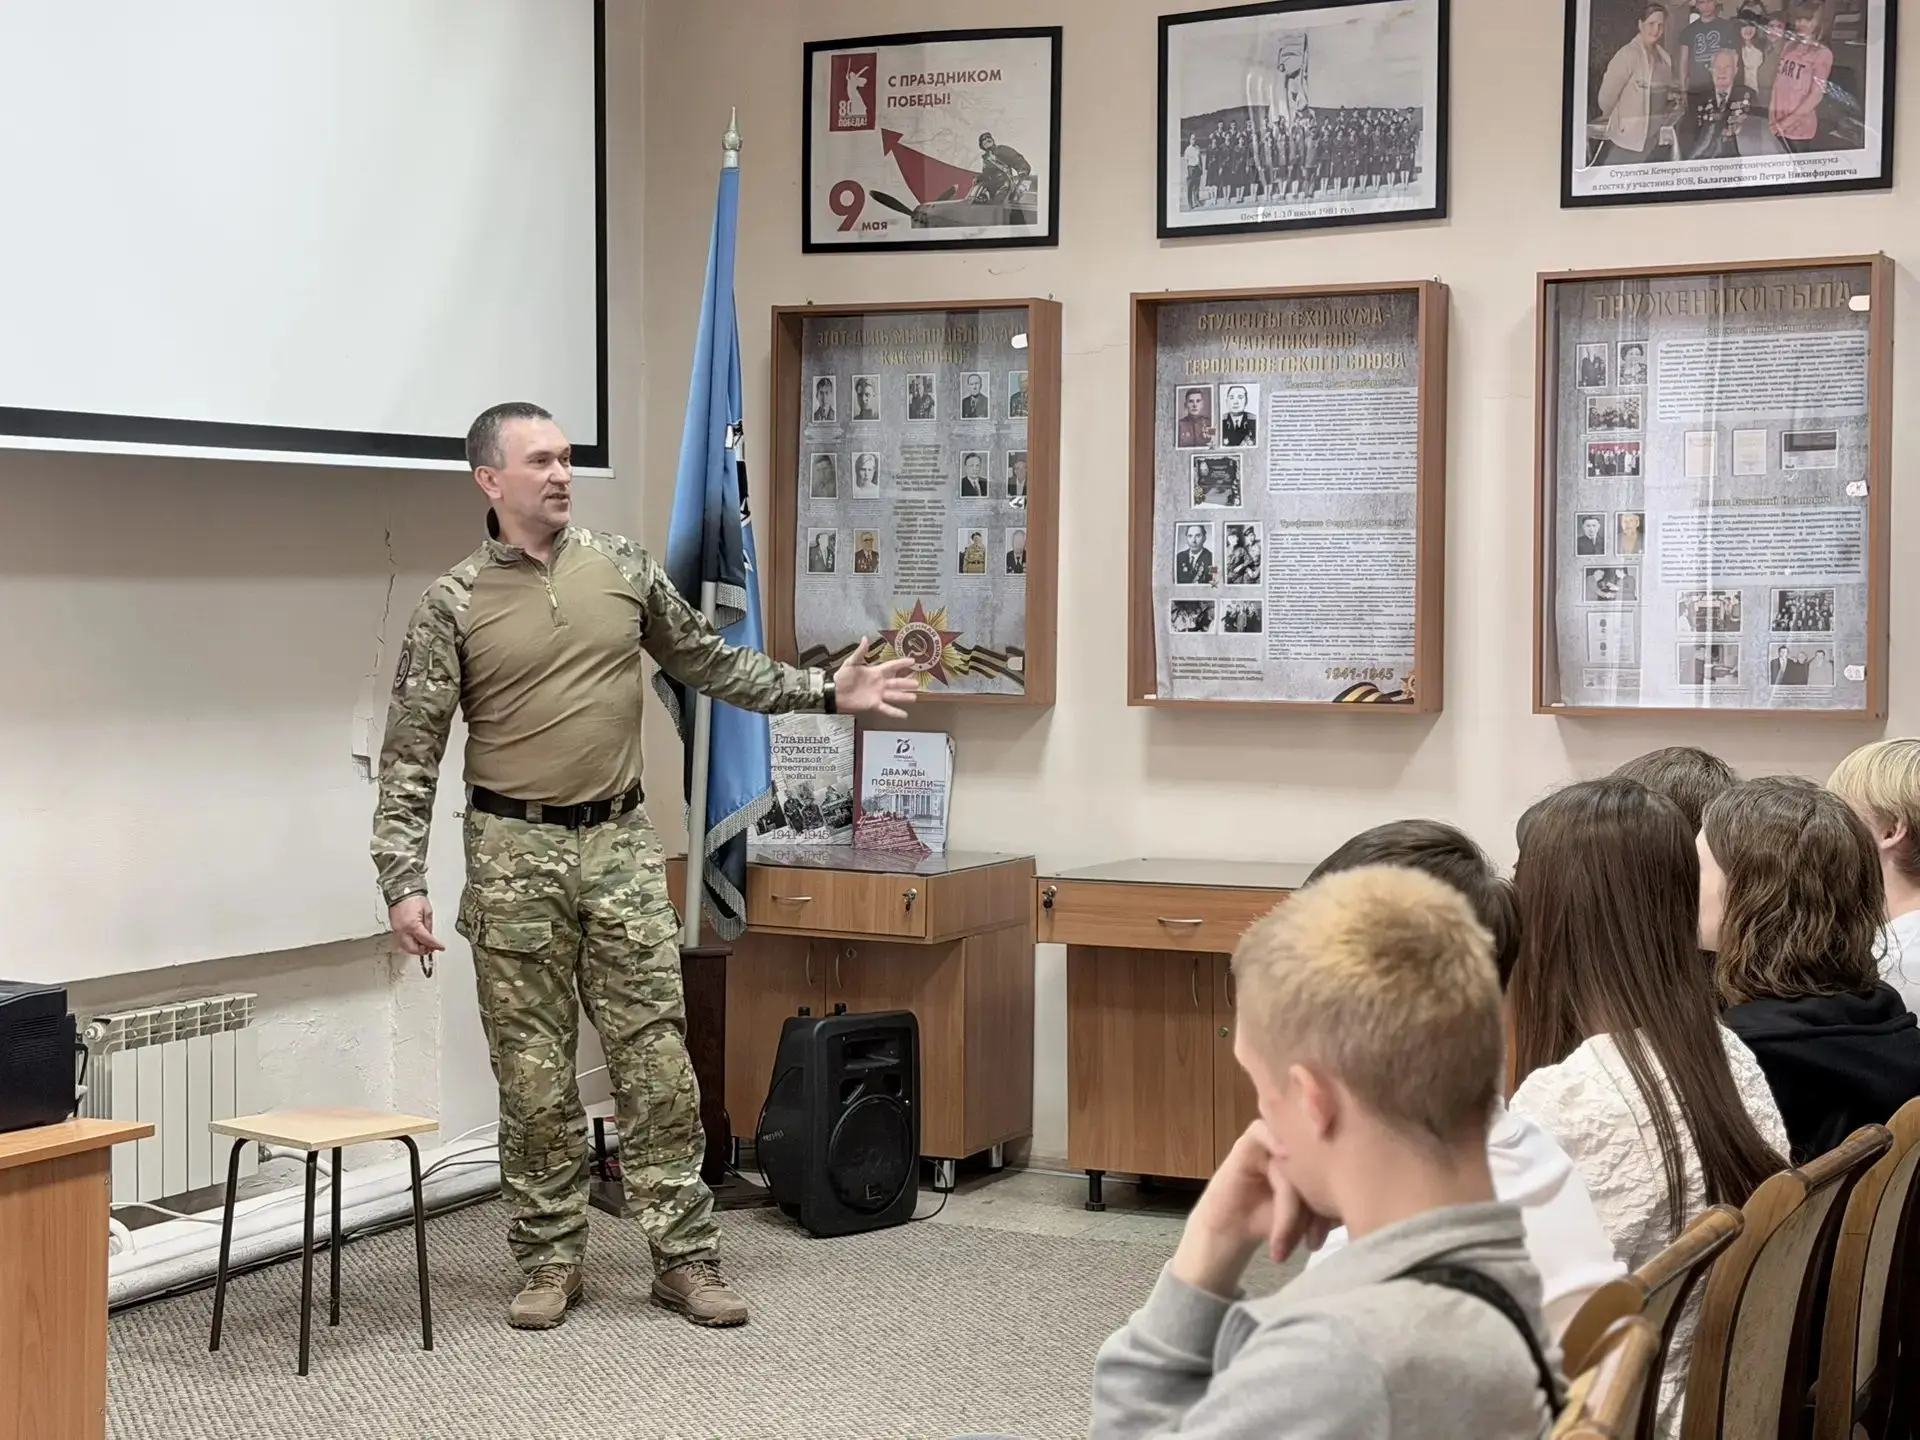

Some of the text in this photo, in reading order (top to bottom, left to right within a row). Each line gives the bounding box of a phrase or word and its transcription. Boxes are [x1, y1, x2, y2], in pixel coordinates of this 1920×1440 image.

[888, 69, 1002, 88] С ПРАЗДНИКОМ
[887, 92, 951, 109] ПОБЕДЫ!
[1609, 168, 1649, 179] Студенты
[1651, 164, 1708, 177] Кемеровского
[1793, 156, 1839, 168] техникума
[1632, 179, 1675, 190] участника
[1677, 176, 1696, 187] ВОВ,
[1697, 173, 1758, 186] Балаганского
[1759, 172, 1786, 182] Петра
[1788, 167, 1858, 180] Никифоровича
[829, 179, 866, 232] 9
[861, 221, 888, 231] мая
[1593, 281, 1850, 321] ТРУЖЕНИКИ ТЫЛА
[1199, 311, 1282, 331] СТУДЕНТЫ
[1221, 333, 1319, 352] УЧАСТНИКИ
[1345, 349, 1407, 371] СОЮЗА
[1325, 667, 1394, 681] 1941-1945
[774, 733, 831, 744] Главные
[771, 745, 839, 756] окументы
[781, 755, 822, 763] Великой
[770, 764, 837, 772] течественной
[881, 768, 926, 777] ДВАЖДЫ
[872, 778, 934, 788] ПОБЕДИТЕЛИ
